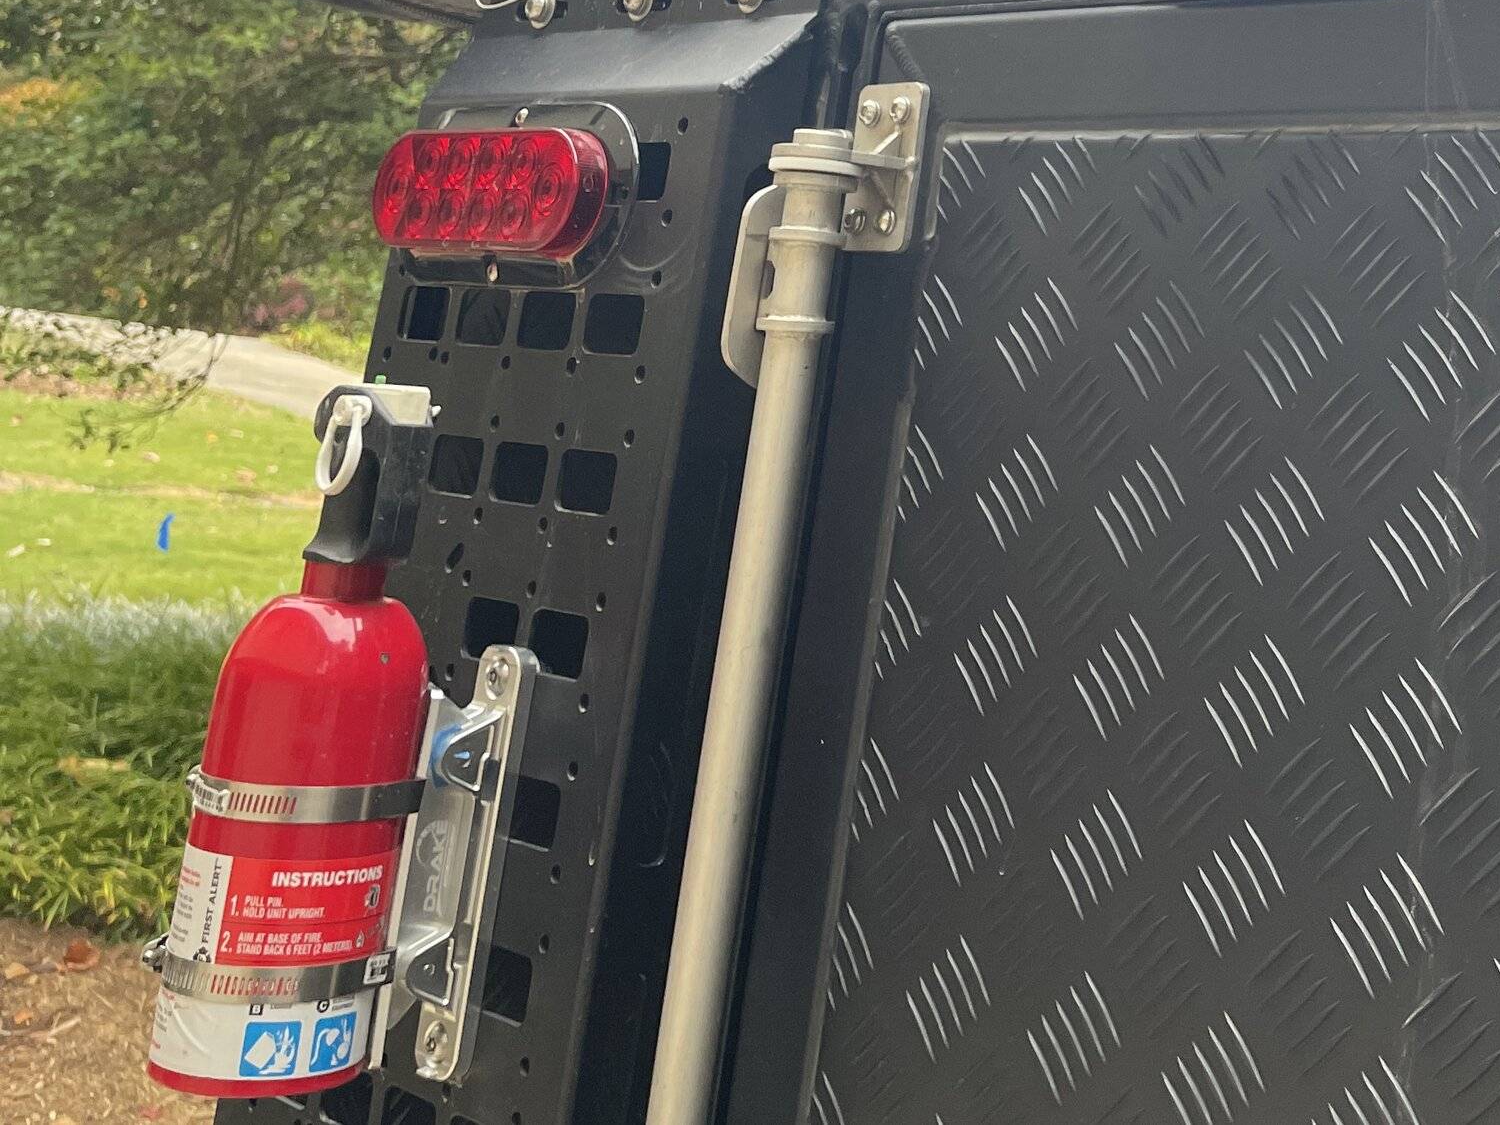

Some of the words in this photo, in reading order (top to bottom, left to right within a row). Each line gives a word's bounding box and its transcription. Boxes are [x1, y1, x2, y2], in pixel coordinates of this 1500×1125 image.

[271, 865, 384, 887] INSTRUCTIONS
[201, 908, 214, 944] FIRST
[209, 865, 222, 905] ALERT
[230, 894, 239, 916] 1.
[244, 895, 265, 907] PULL
[266, 896, 284, 908] PIN.
[242, 907, 265, 919] HOLD
[267, 907, 287, 919] UNIT
[220, 931, 233, 953] 2.
[237, 931, 254, 943] AIM
[255, 932, 266, 944] AT
[267, 933, 289, 945] BASE
[290, 933, 302, 944] OF
[236, 943, 263, 955] STAND
[263, 943, 286, 956] BACK
[286, 944, 292, 956] 6
[292, 943, 312, 956] FEET
